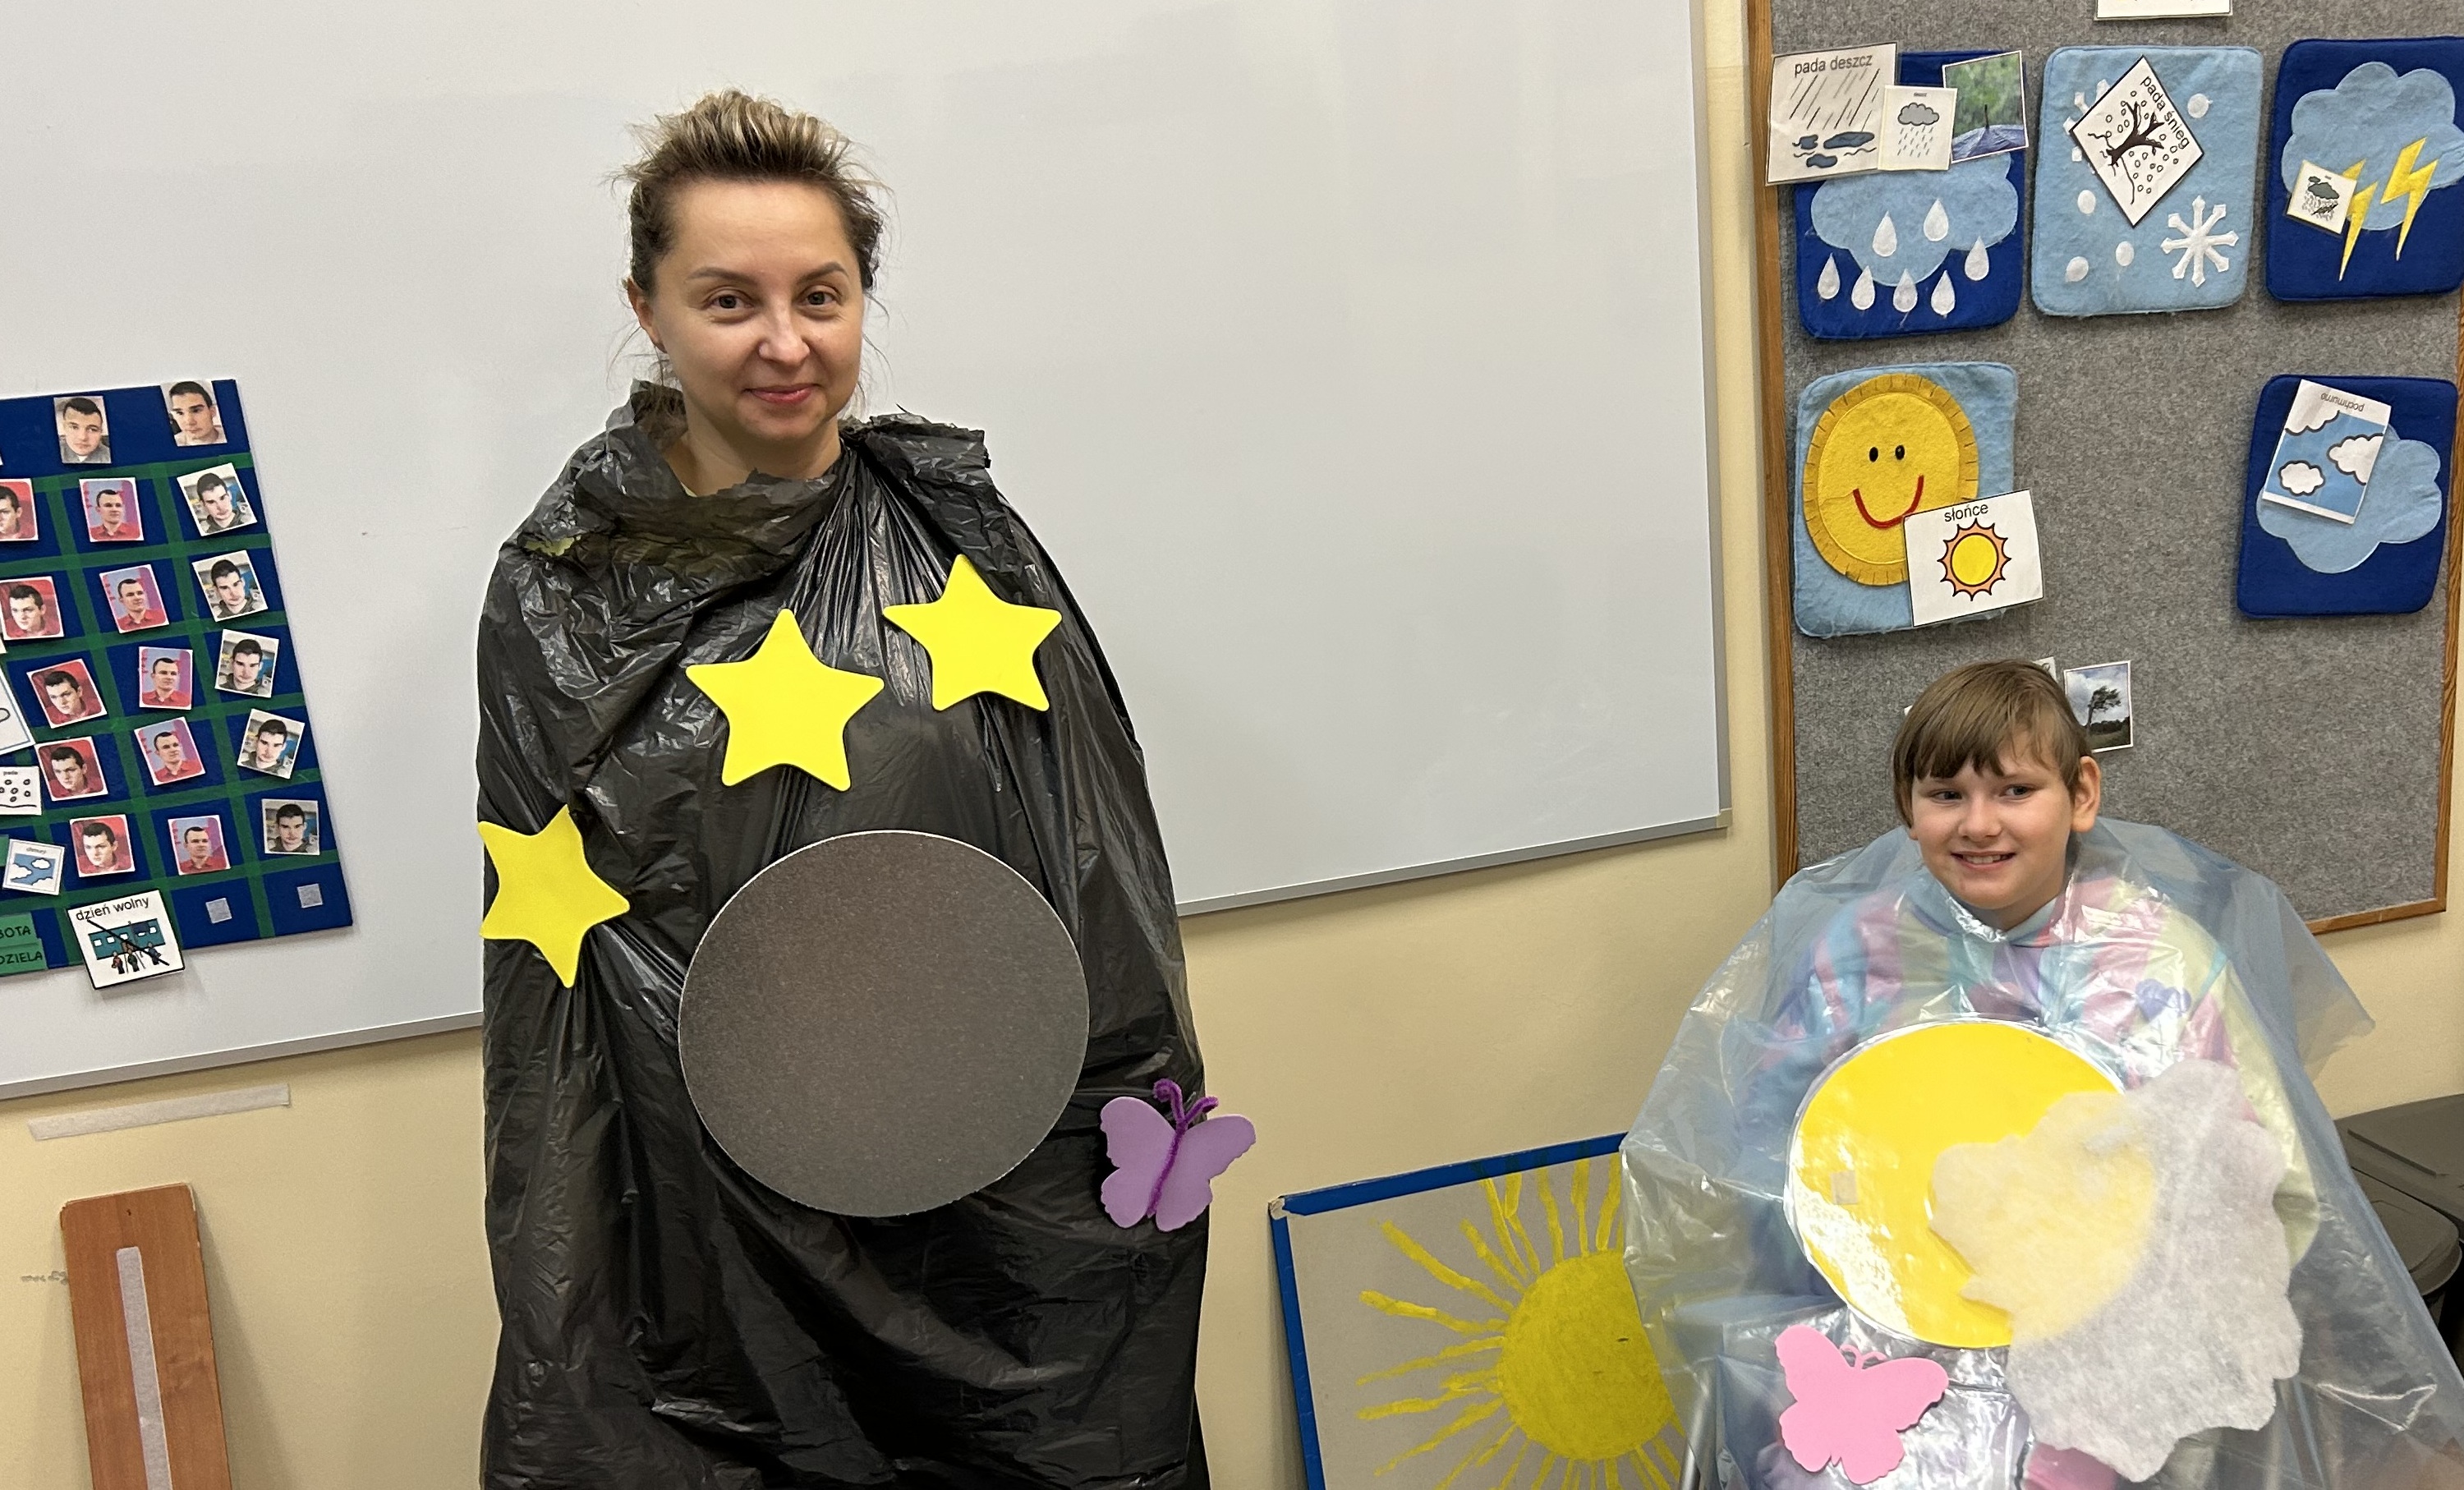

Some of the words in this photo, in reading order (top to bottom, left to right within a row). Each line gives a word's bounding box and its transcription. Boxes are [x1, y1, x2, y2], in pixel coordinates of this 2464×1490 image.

[1795, 57, 1826, 78] pada
[1830, 55, 1873, 71] deszcz
[2140, 76, 2166, 112] pada
[2164, 110, 2190, 149] śnieg
[1944, 504, 1988, 522] słońce
[76, 904, 111, 921] dzień
[113, 897, 149, 912] wolny
